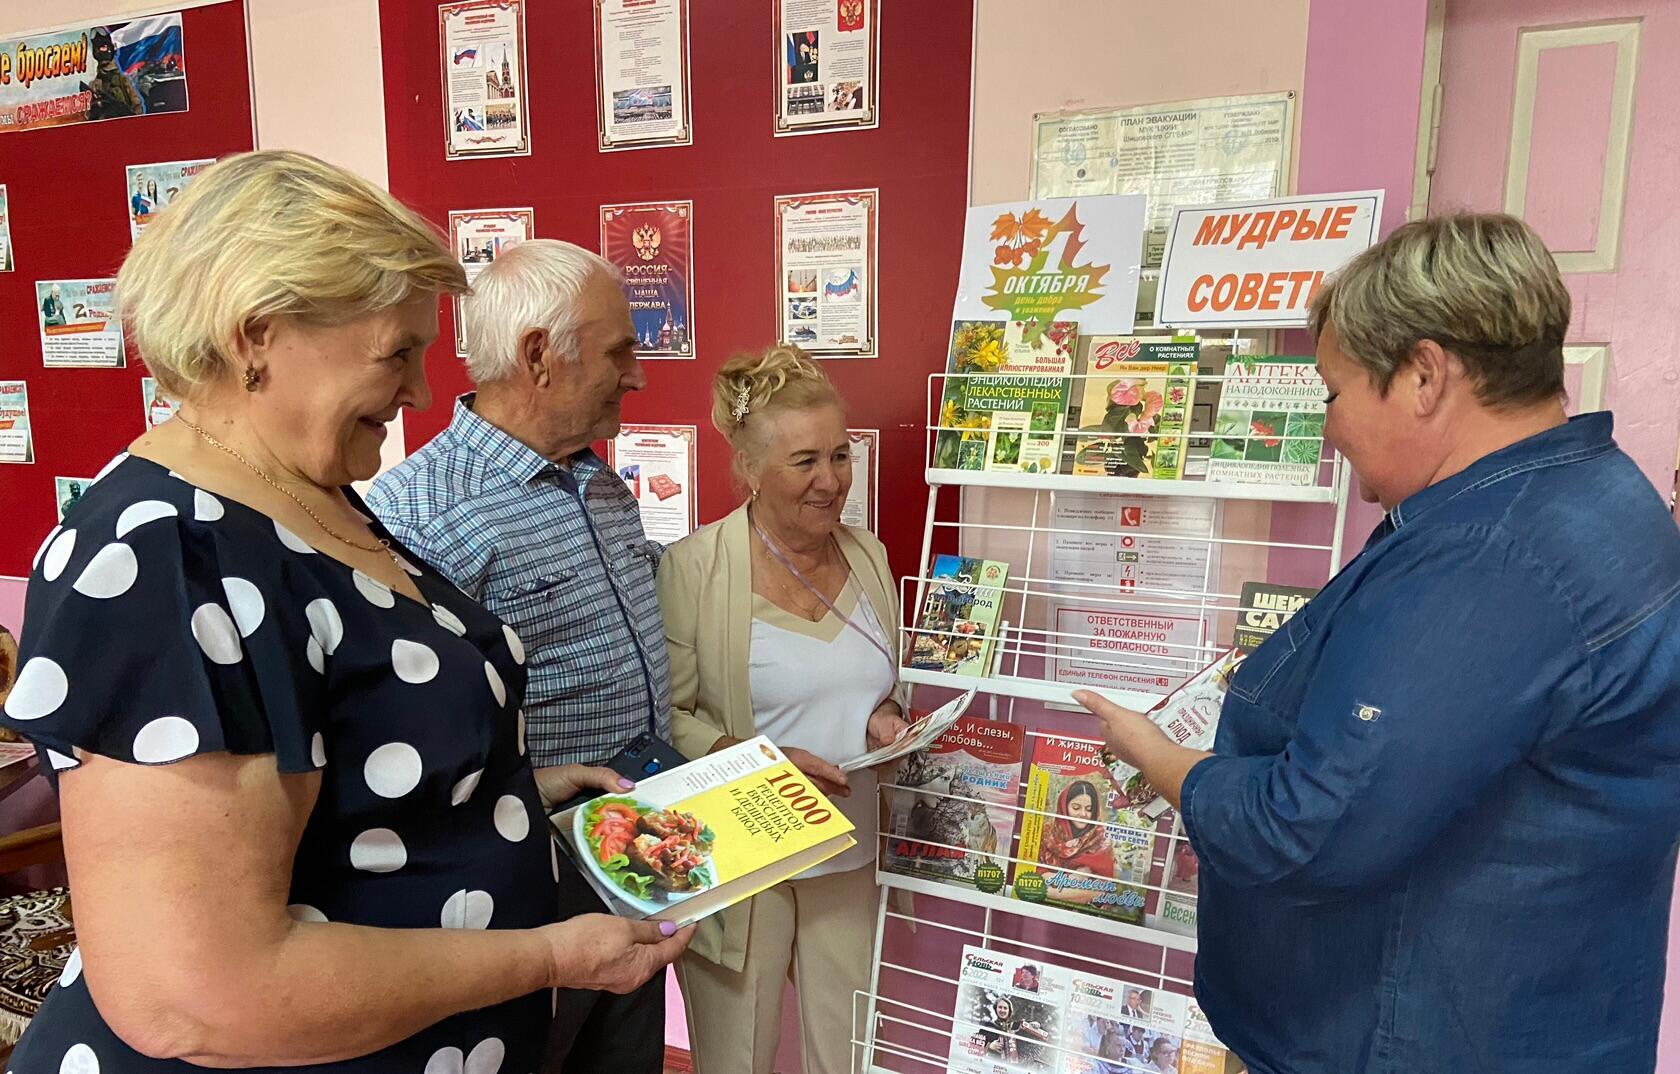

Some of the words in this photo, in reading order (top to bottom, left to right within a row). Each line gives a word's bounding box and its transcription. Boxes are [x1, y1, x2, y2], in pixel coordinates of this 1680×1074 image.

[16, 32, 87, 88] бросаем!
[1146, 112, 1197, 125] ЭВАКУАЦИИ
[1192, 205, 1358, 250] МУДРЫЕ
[1036, 231, 1074, 273] 1
[1003, 274, 1090, 294] ОКТЯБРЯ
[1000, 364, 1065, 373] ИЛЛЮСТРИРОВАННАЯ
[1035, 356, 1066, 365] БОЛЬШАЯ
[970, 376, 1063, 388] ЭНЦИКЛОПЕДИЯ
[1228, 364, 1327, 386] АПТЕКА
[968, 386, 1062, 399] ЛЕКАРСТВЕННЫХ
[1226, 385, 1242, 394] НА
[1242, 386, 1324, 397] ПОДОКОННИКЕ
[967, 398, 1024, 410] РАСТЕНИЙ
[1087, 615, 1174, 631] ОТВЕТСТВЕННЫЙ
[1093, 627, 1107, 637] ЗА
[1108, 628, 1167, 642] ПОЖАРНУЮ
[1089, 638, 1169, 654] БЕЗОПАСНОСТЬ
[1059, 669, 1086, 677] ЕДИНЫЙ
[1087, 671, 1118, 680] ТЕЛЕФОН
[1119, 675, 1155, 684] СПАСЕНИЯ
[966, 723, 975, 733] И
[977, 726, 1014, 741] слезы,
[1167, 719, 1191, 744] БЛЮД
[941, 734, 993, 749] любовь...
[1062, 751, 1072, 761] И
[961, 775, 1007, 788] РОДНИК
[729, 788, 742, 796] И
[765, 770, 832, 825] 1000
[746, 789, 792, 834] ВКУСНЫХ
[756, 783, 805, 831] РЕЦЕПТОВ
[731, 806, 761, 836] БЛЮД
[735, 797, 784, 843] ДЕШЕВЫХ
[1045, 870, 1117, 893] Аромат
[1093, 890, 1146, 908] любви
[1163, 901, 1196, 925] Весен
[962, 967, 969, 976] 6
[1185, 1019, 1192, 1029] 2
